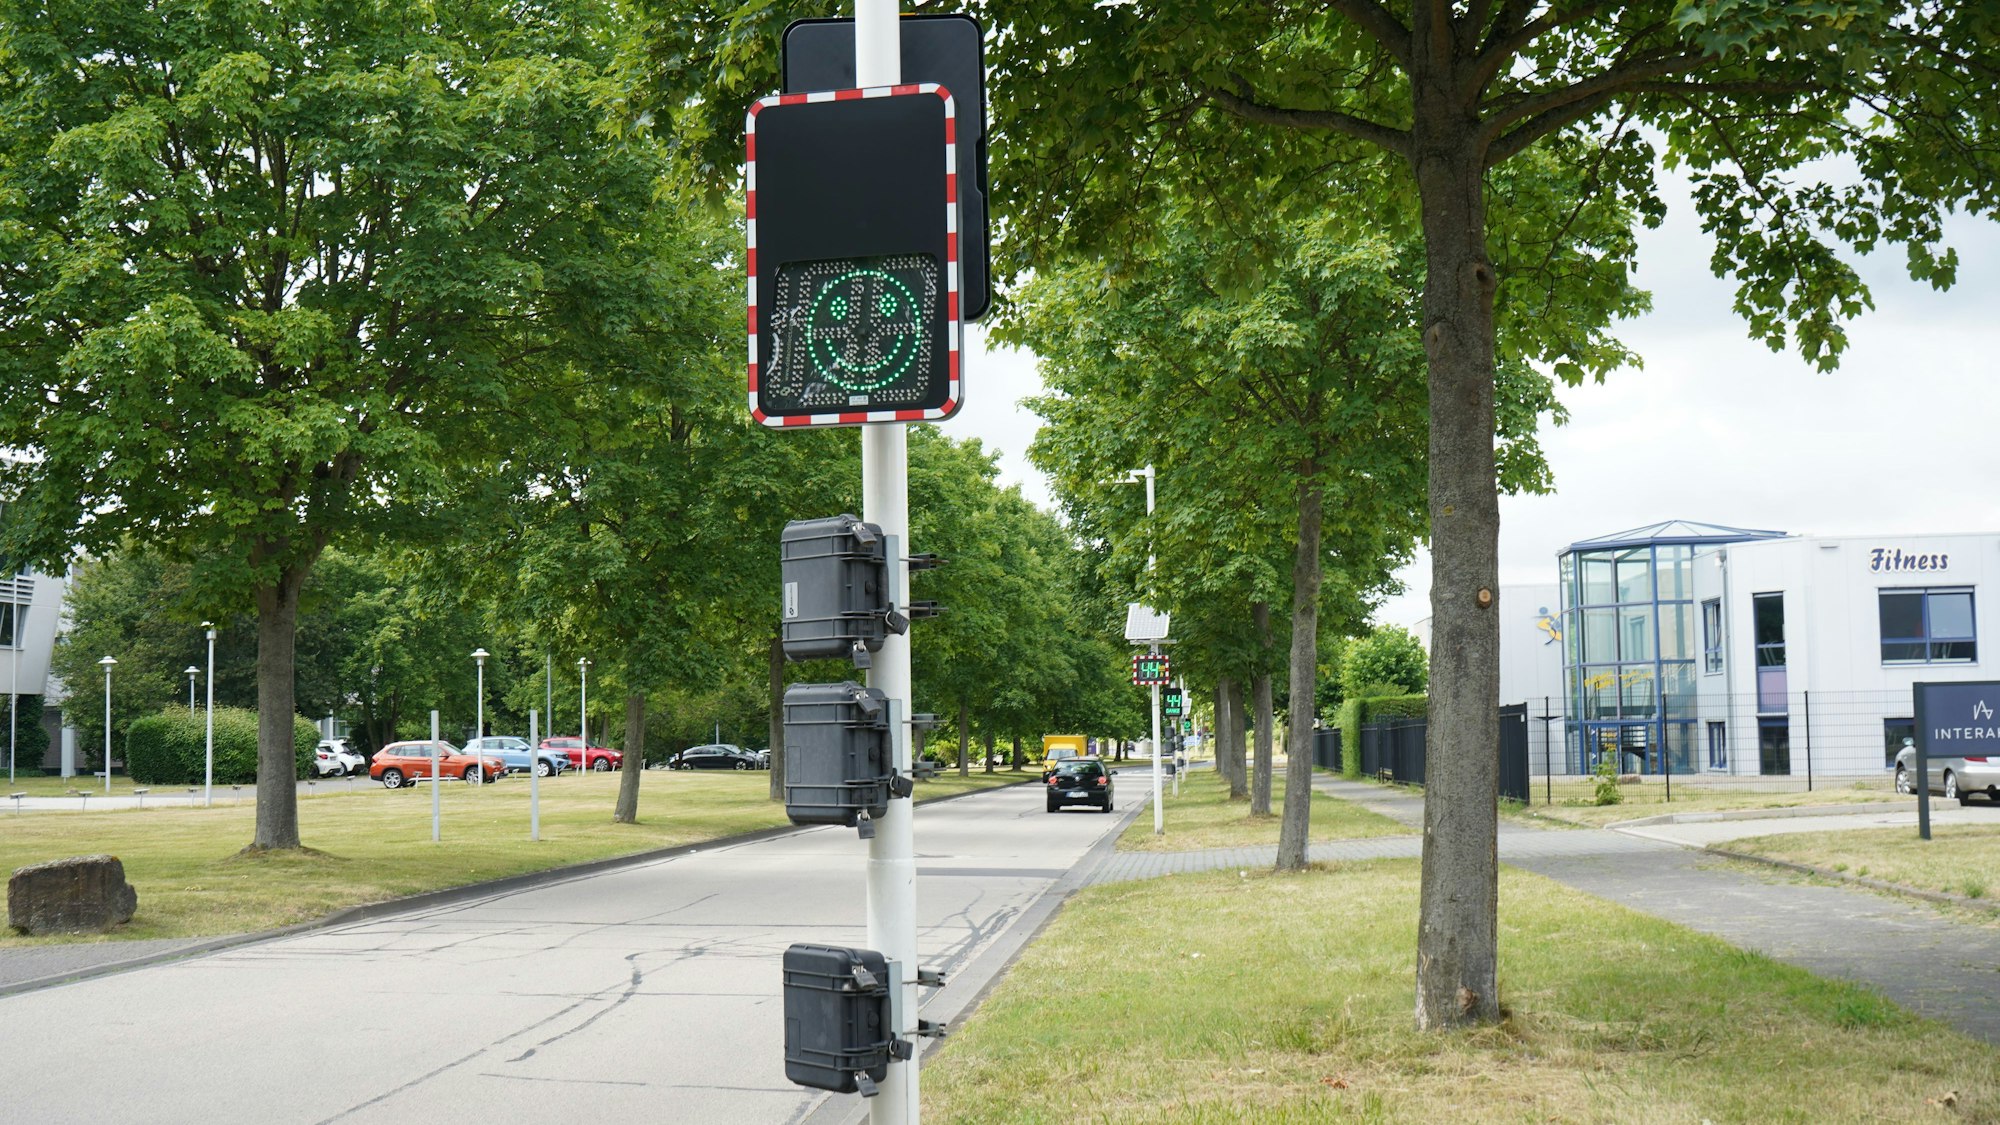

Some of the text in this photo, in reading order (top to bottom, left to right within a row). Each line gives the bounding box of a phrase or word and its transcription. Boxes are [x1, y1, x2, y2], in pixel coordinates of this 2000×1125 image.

[1871, 548, 1949, 571] Fitness
[1141, 662, 1159, 678] 44
[1167, 694, 1181, 707] 44
